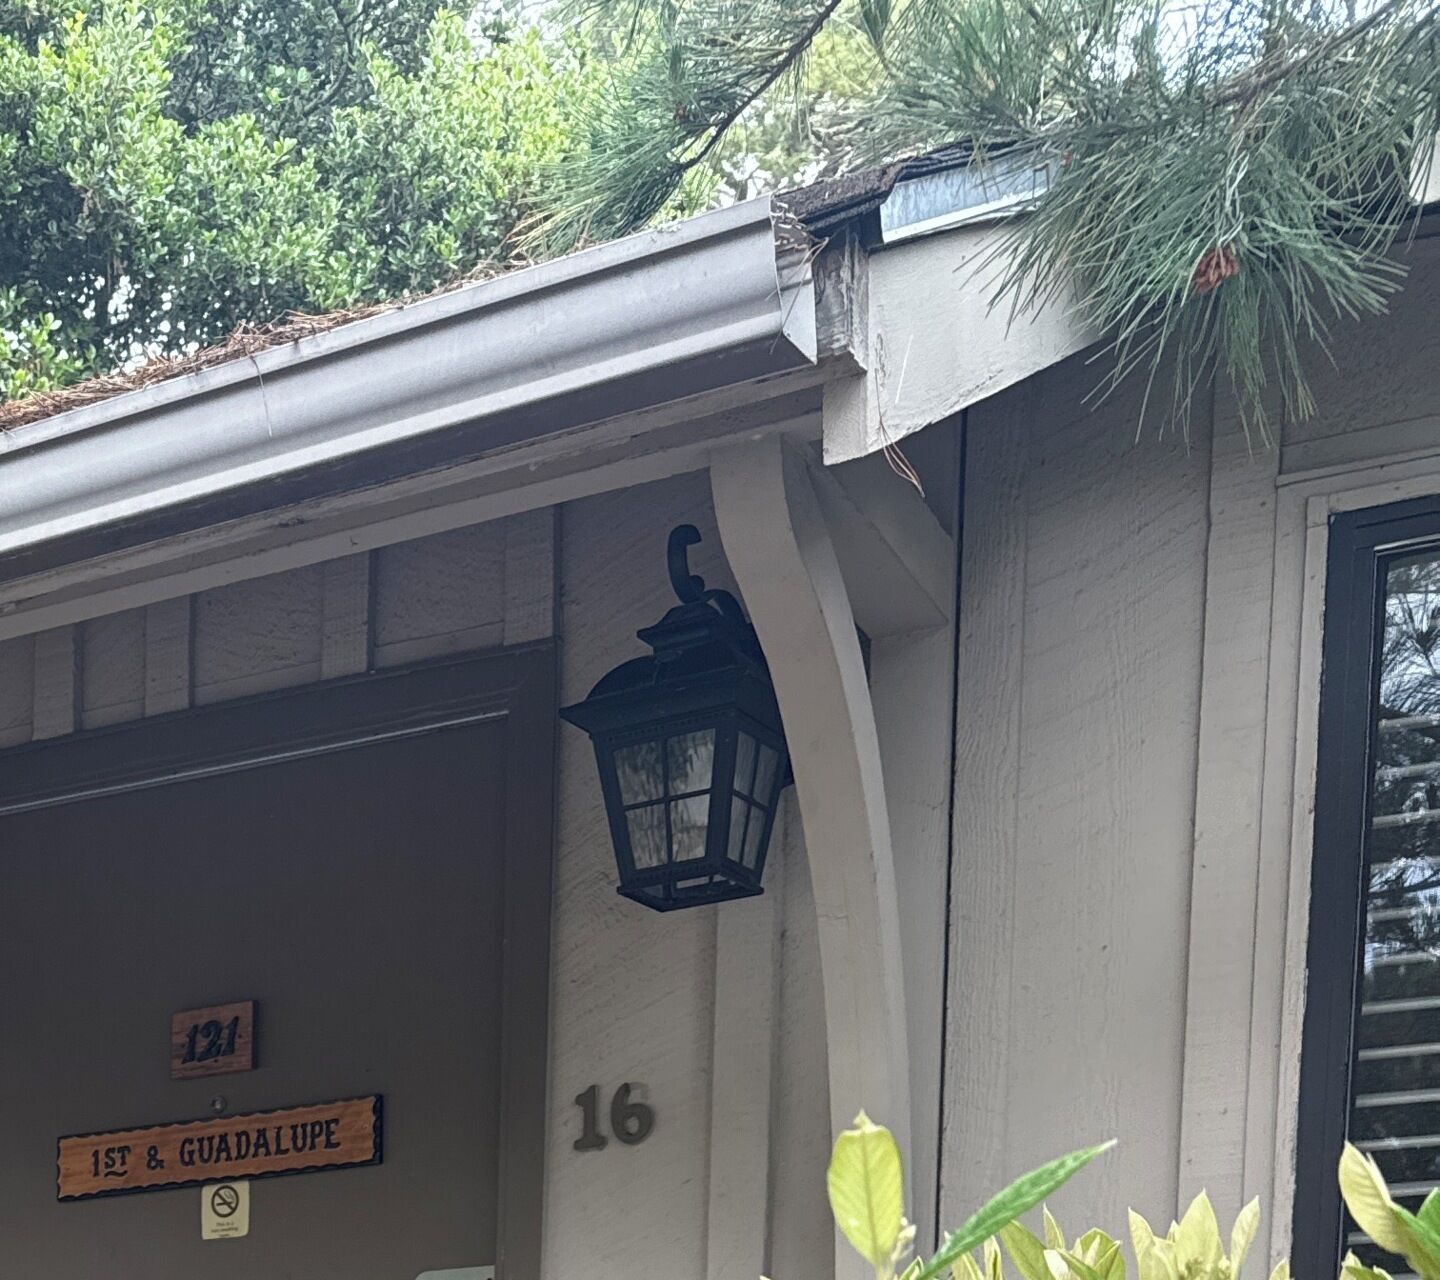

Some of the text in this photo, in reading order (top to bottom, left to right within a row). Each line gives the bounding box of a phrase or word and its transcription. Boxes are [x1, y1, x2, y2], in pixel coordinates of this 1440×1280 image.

[181, 1015, 240, 1065] 121
[573, 1082, 656, 1152] 16
[92, 1118, 341, 1178] 1ST & GUADALUPE
